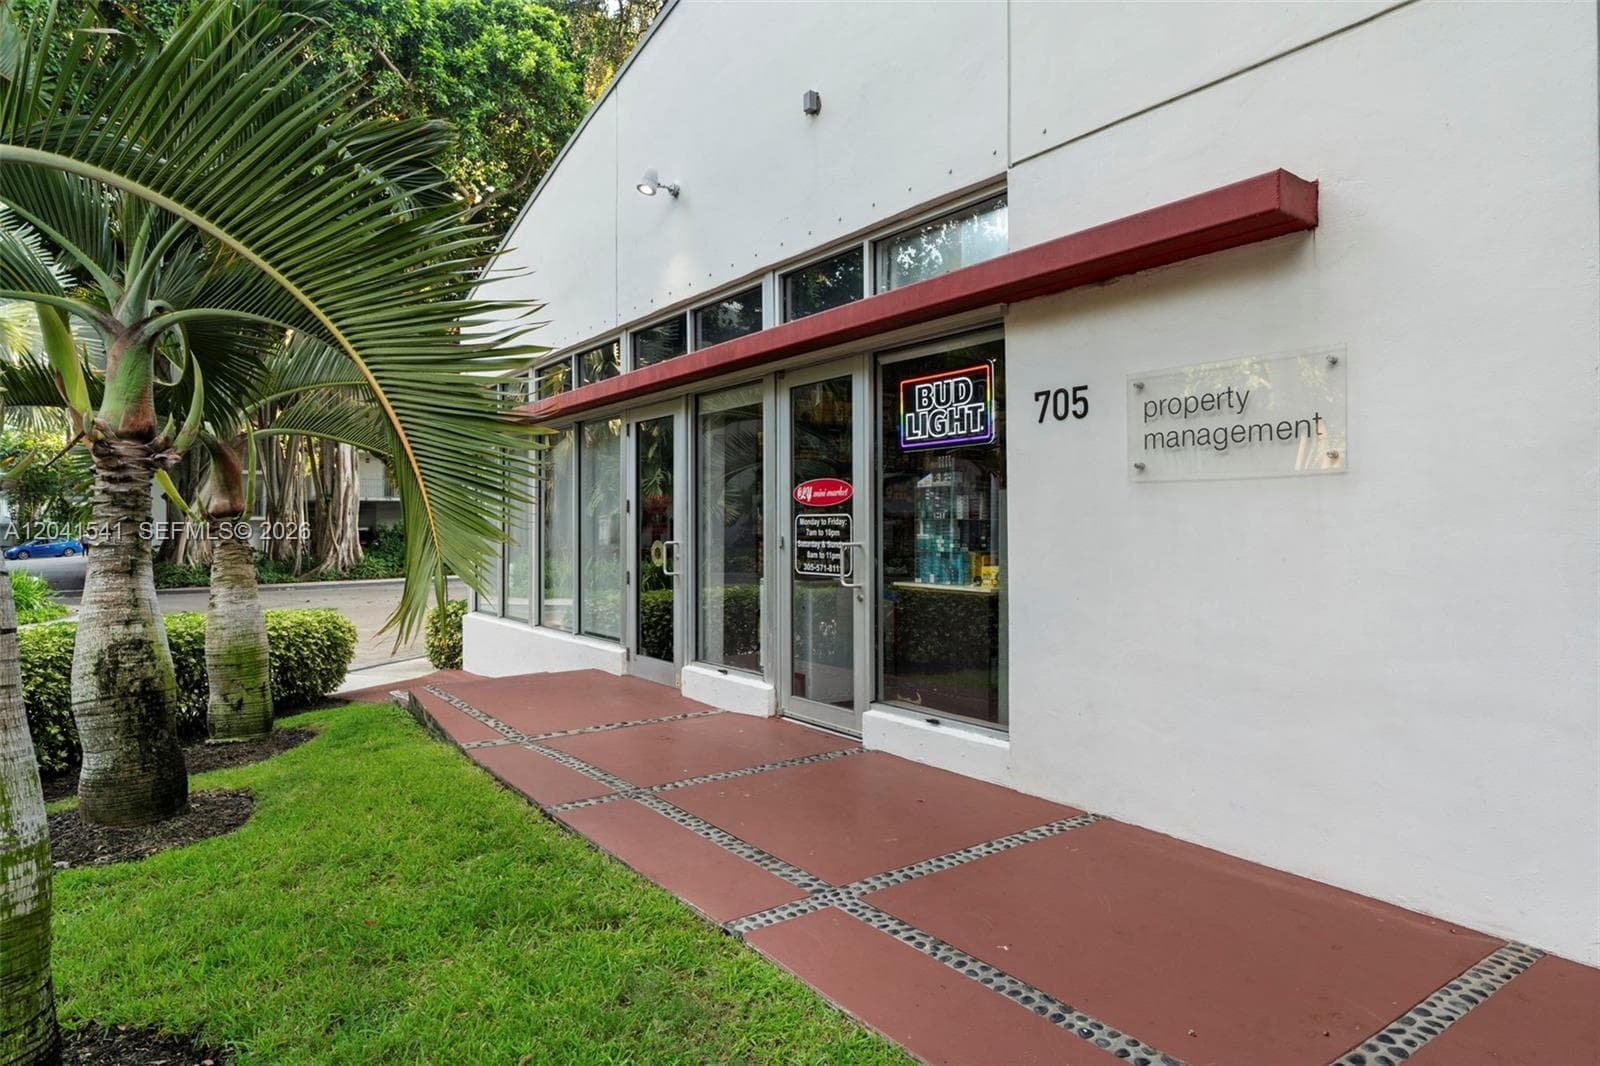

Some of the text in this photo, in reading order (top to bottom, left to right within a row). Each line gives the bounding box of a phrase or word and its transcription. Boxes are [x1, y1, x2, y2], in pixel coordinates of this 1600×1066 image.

[916, 377, 973, 412] BUD
[1034, 385, 1089, 424] 705
[1144, 386, 1250, 423] property
[1144, 412, 1323, 450] management
[813, 488, 826, 498] mini
[826, 486, 849, 497] market
[799, 518, 820, 527] Monday
[806, 528, 817, 536] 7am
